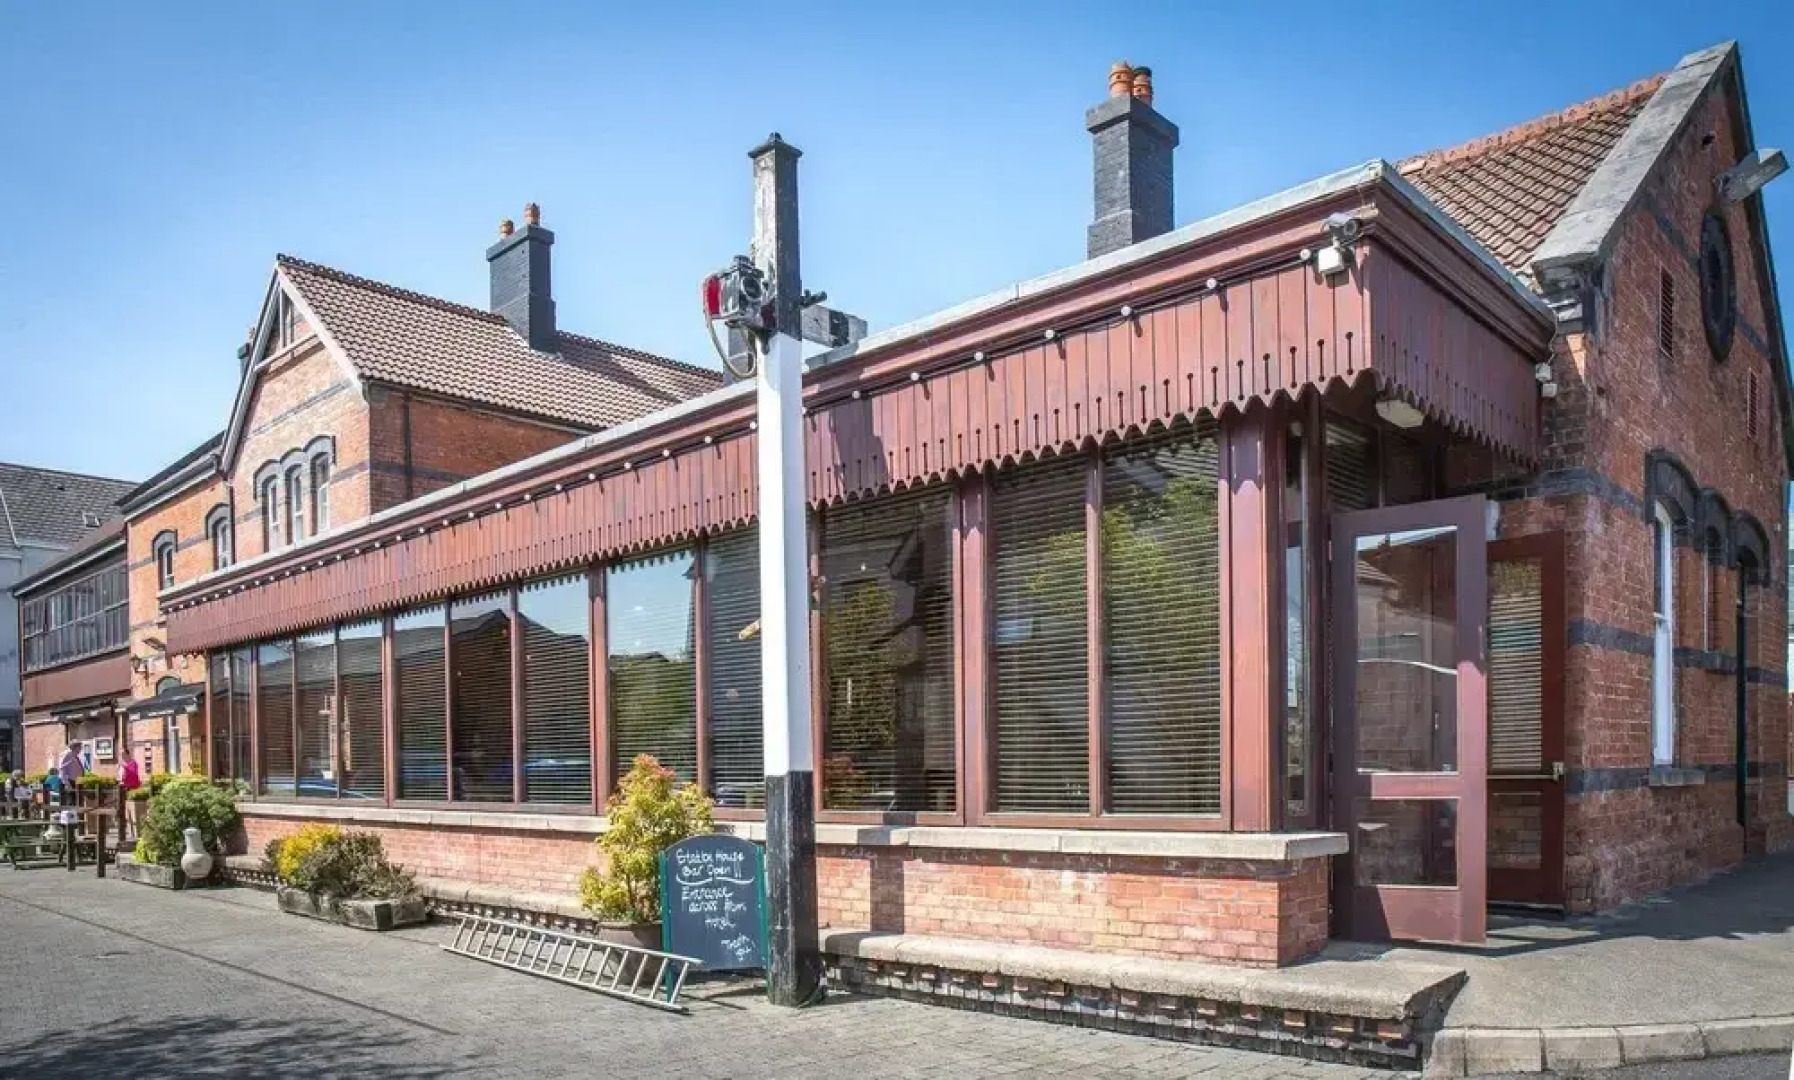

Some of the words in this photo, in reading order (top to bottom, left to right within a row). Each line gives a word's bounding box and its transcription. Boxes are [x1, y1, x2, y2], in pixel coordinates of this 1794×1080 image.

[716, 850, 744, 861] House
[682, 866, 703, 876] Bar
[688, 901, 718, 912] across
